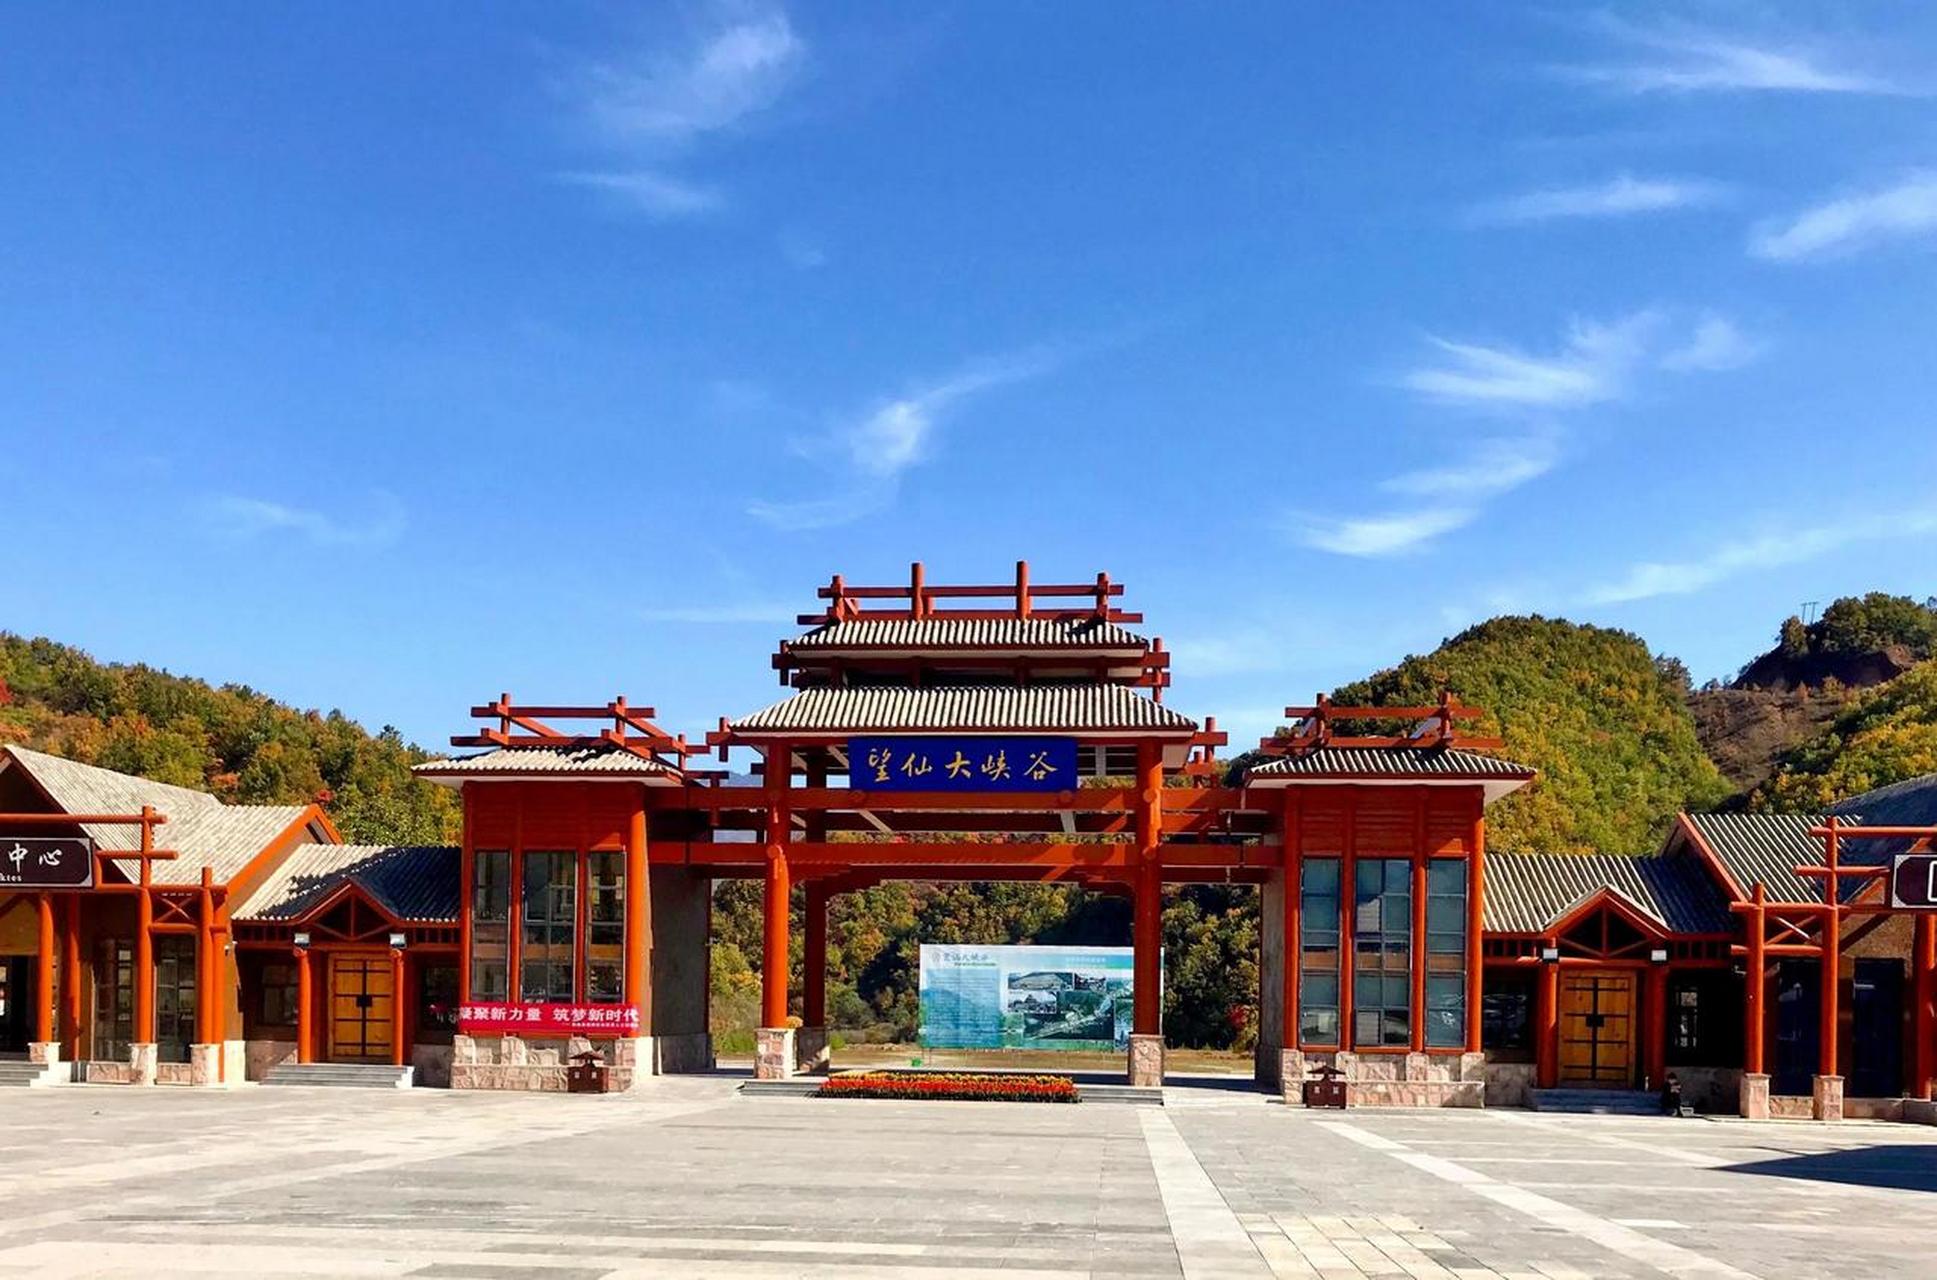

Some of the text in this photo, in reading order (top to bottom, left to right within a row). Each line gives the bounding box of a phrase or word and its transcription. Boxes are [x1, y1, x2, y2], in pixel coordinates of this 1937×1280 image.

[868, 748, 1058, 782] 望仙大峡谷
[8, 842, 62, 873] 中心
[553, 1007, 639, 1022] 筑梦新时代
